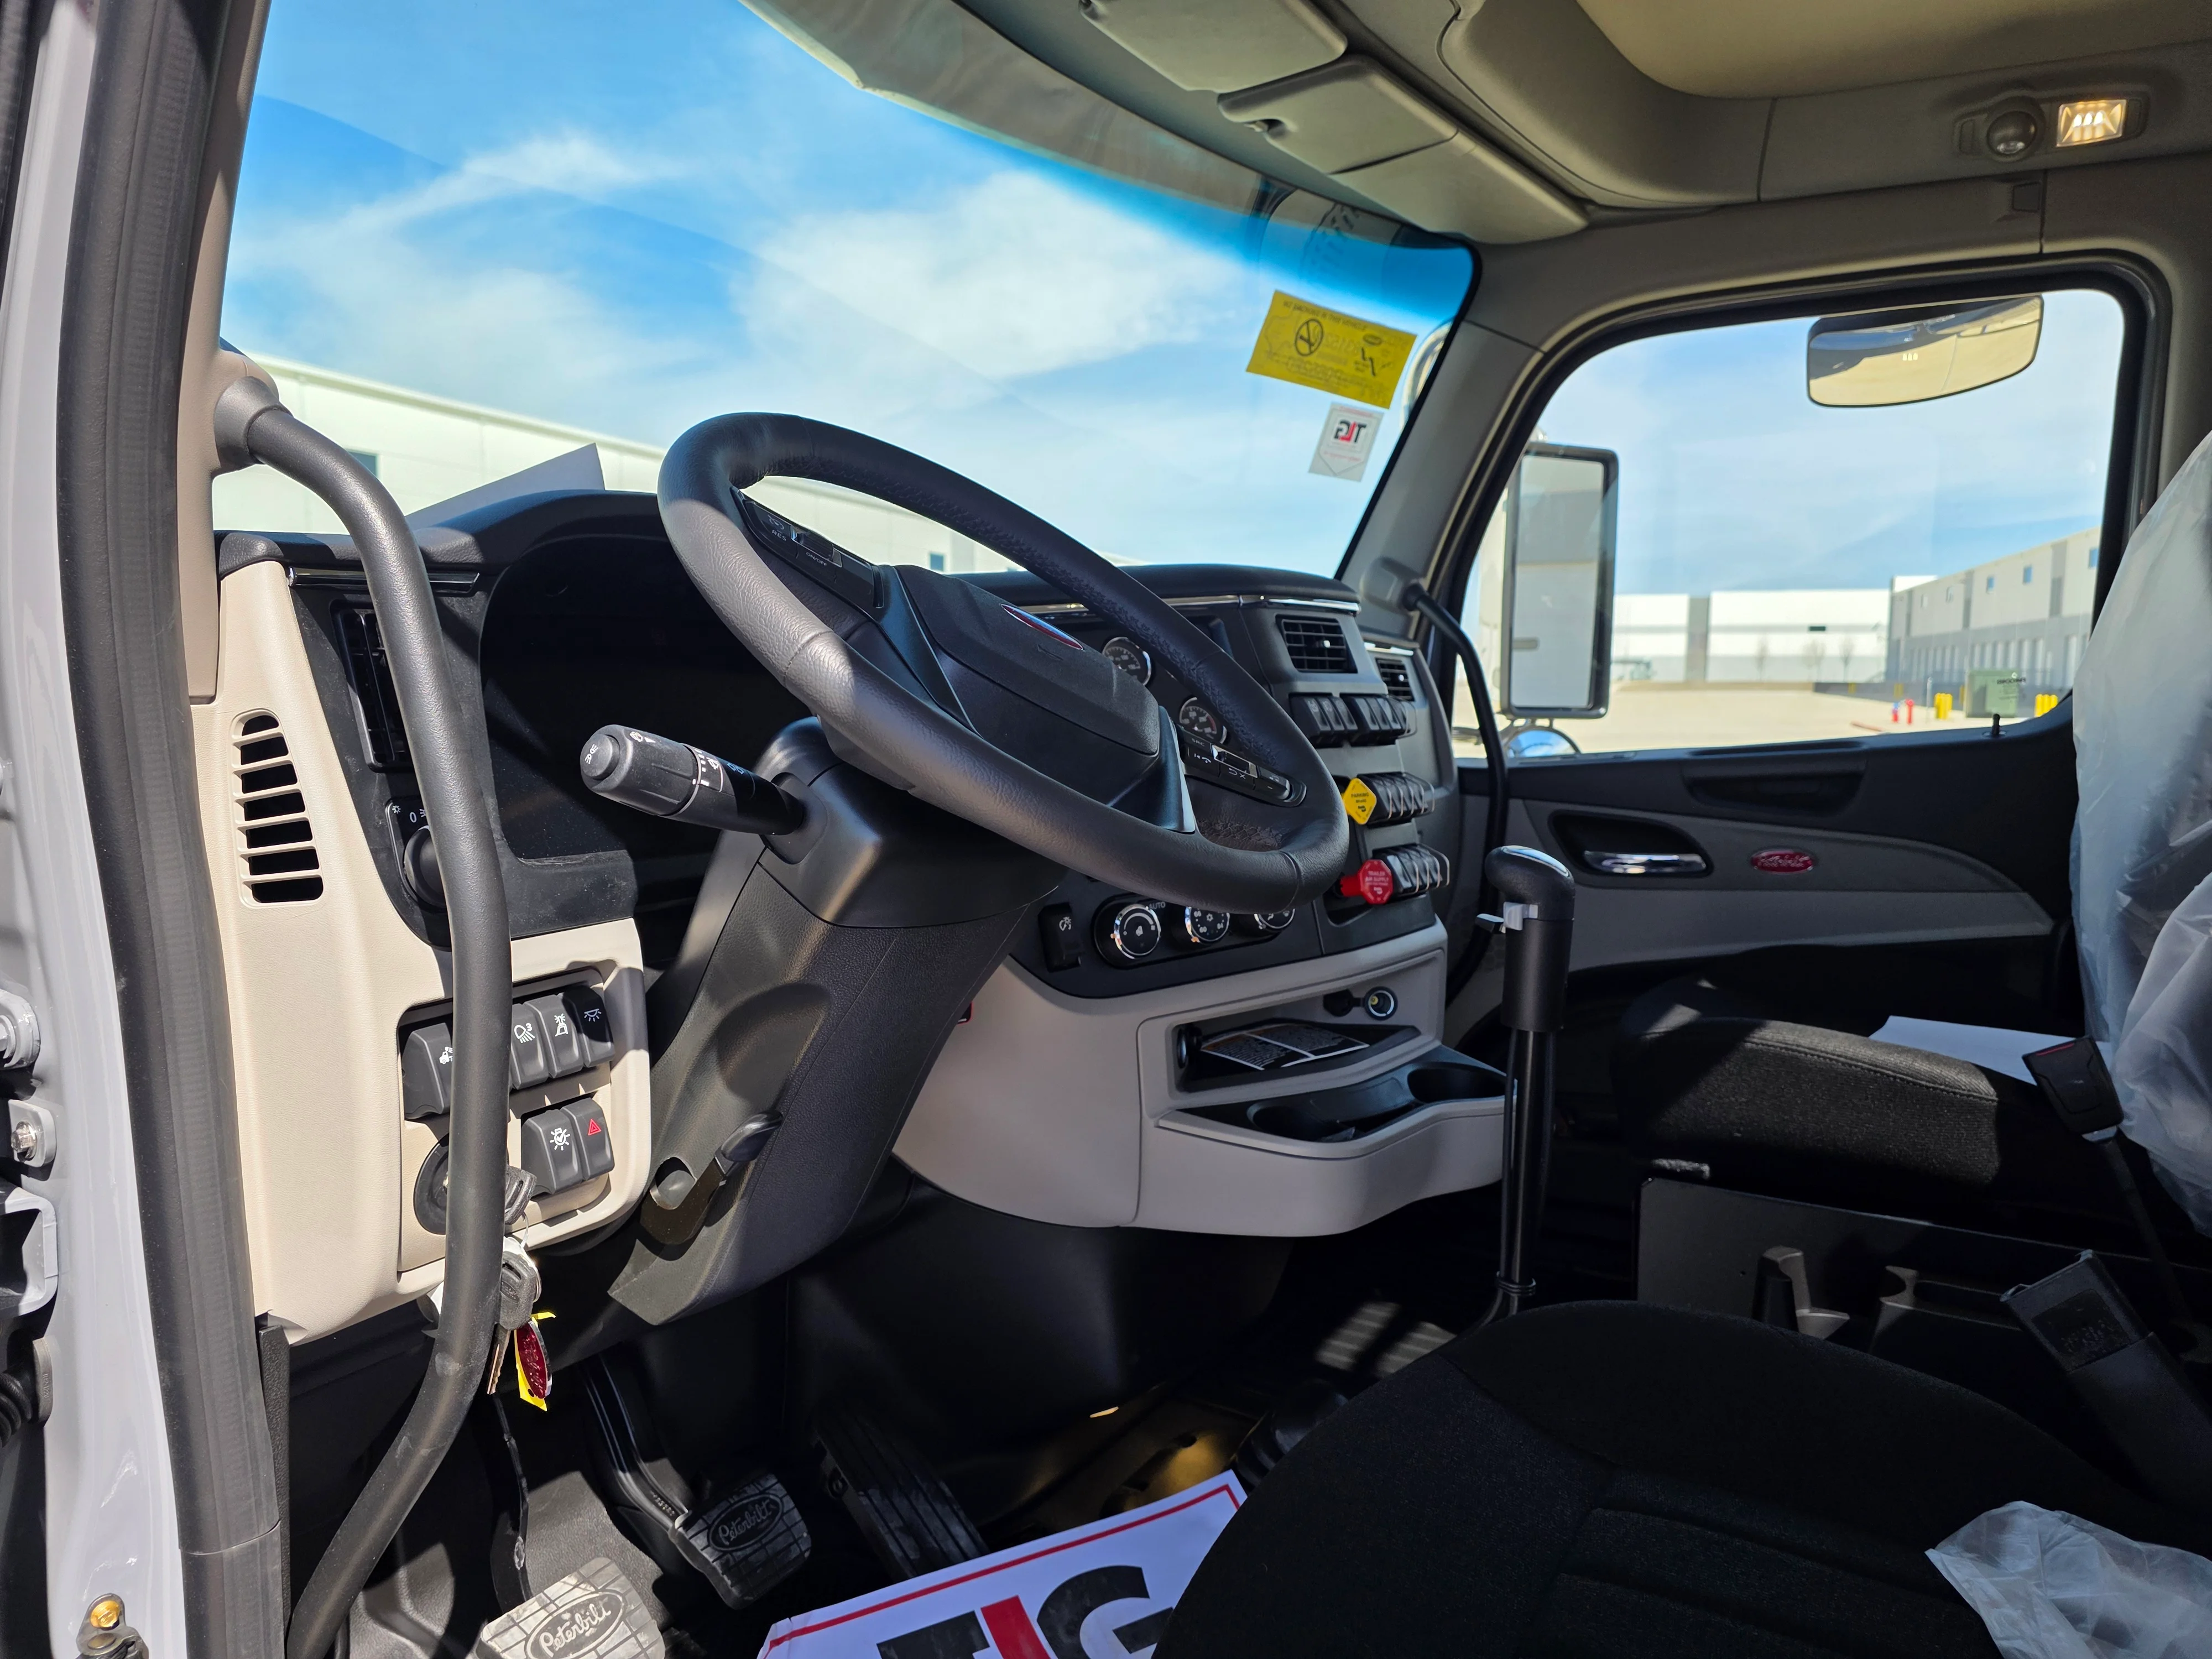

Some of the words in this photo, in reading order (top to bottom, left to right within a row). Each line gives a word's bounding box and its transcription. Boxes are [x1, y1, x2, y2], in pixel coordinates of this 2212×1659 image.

[773, 530, 786, 541] RES
[806, 552, 827, 566] ON/OFF
[1191, 738, 1206, 747] SRC
[719, 1499, 772, 1545] Peterbilt
[539, 1603, 612, 1658] Peterbilt
